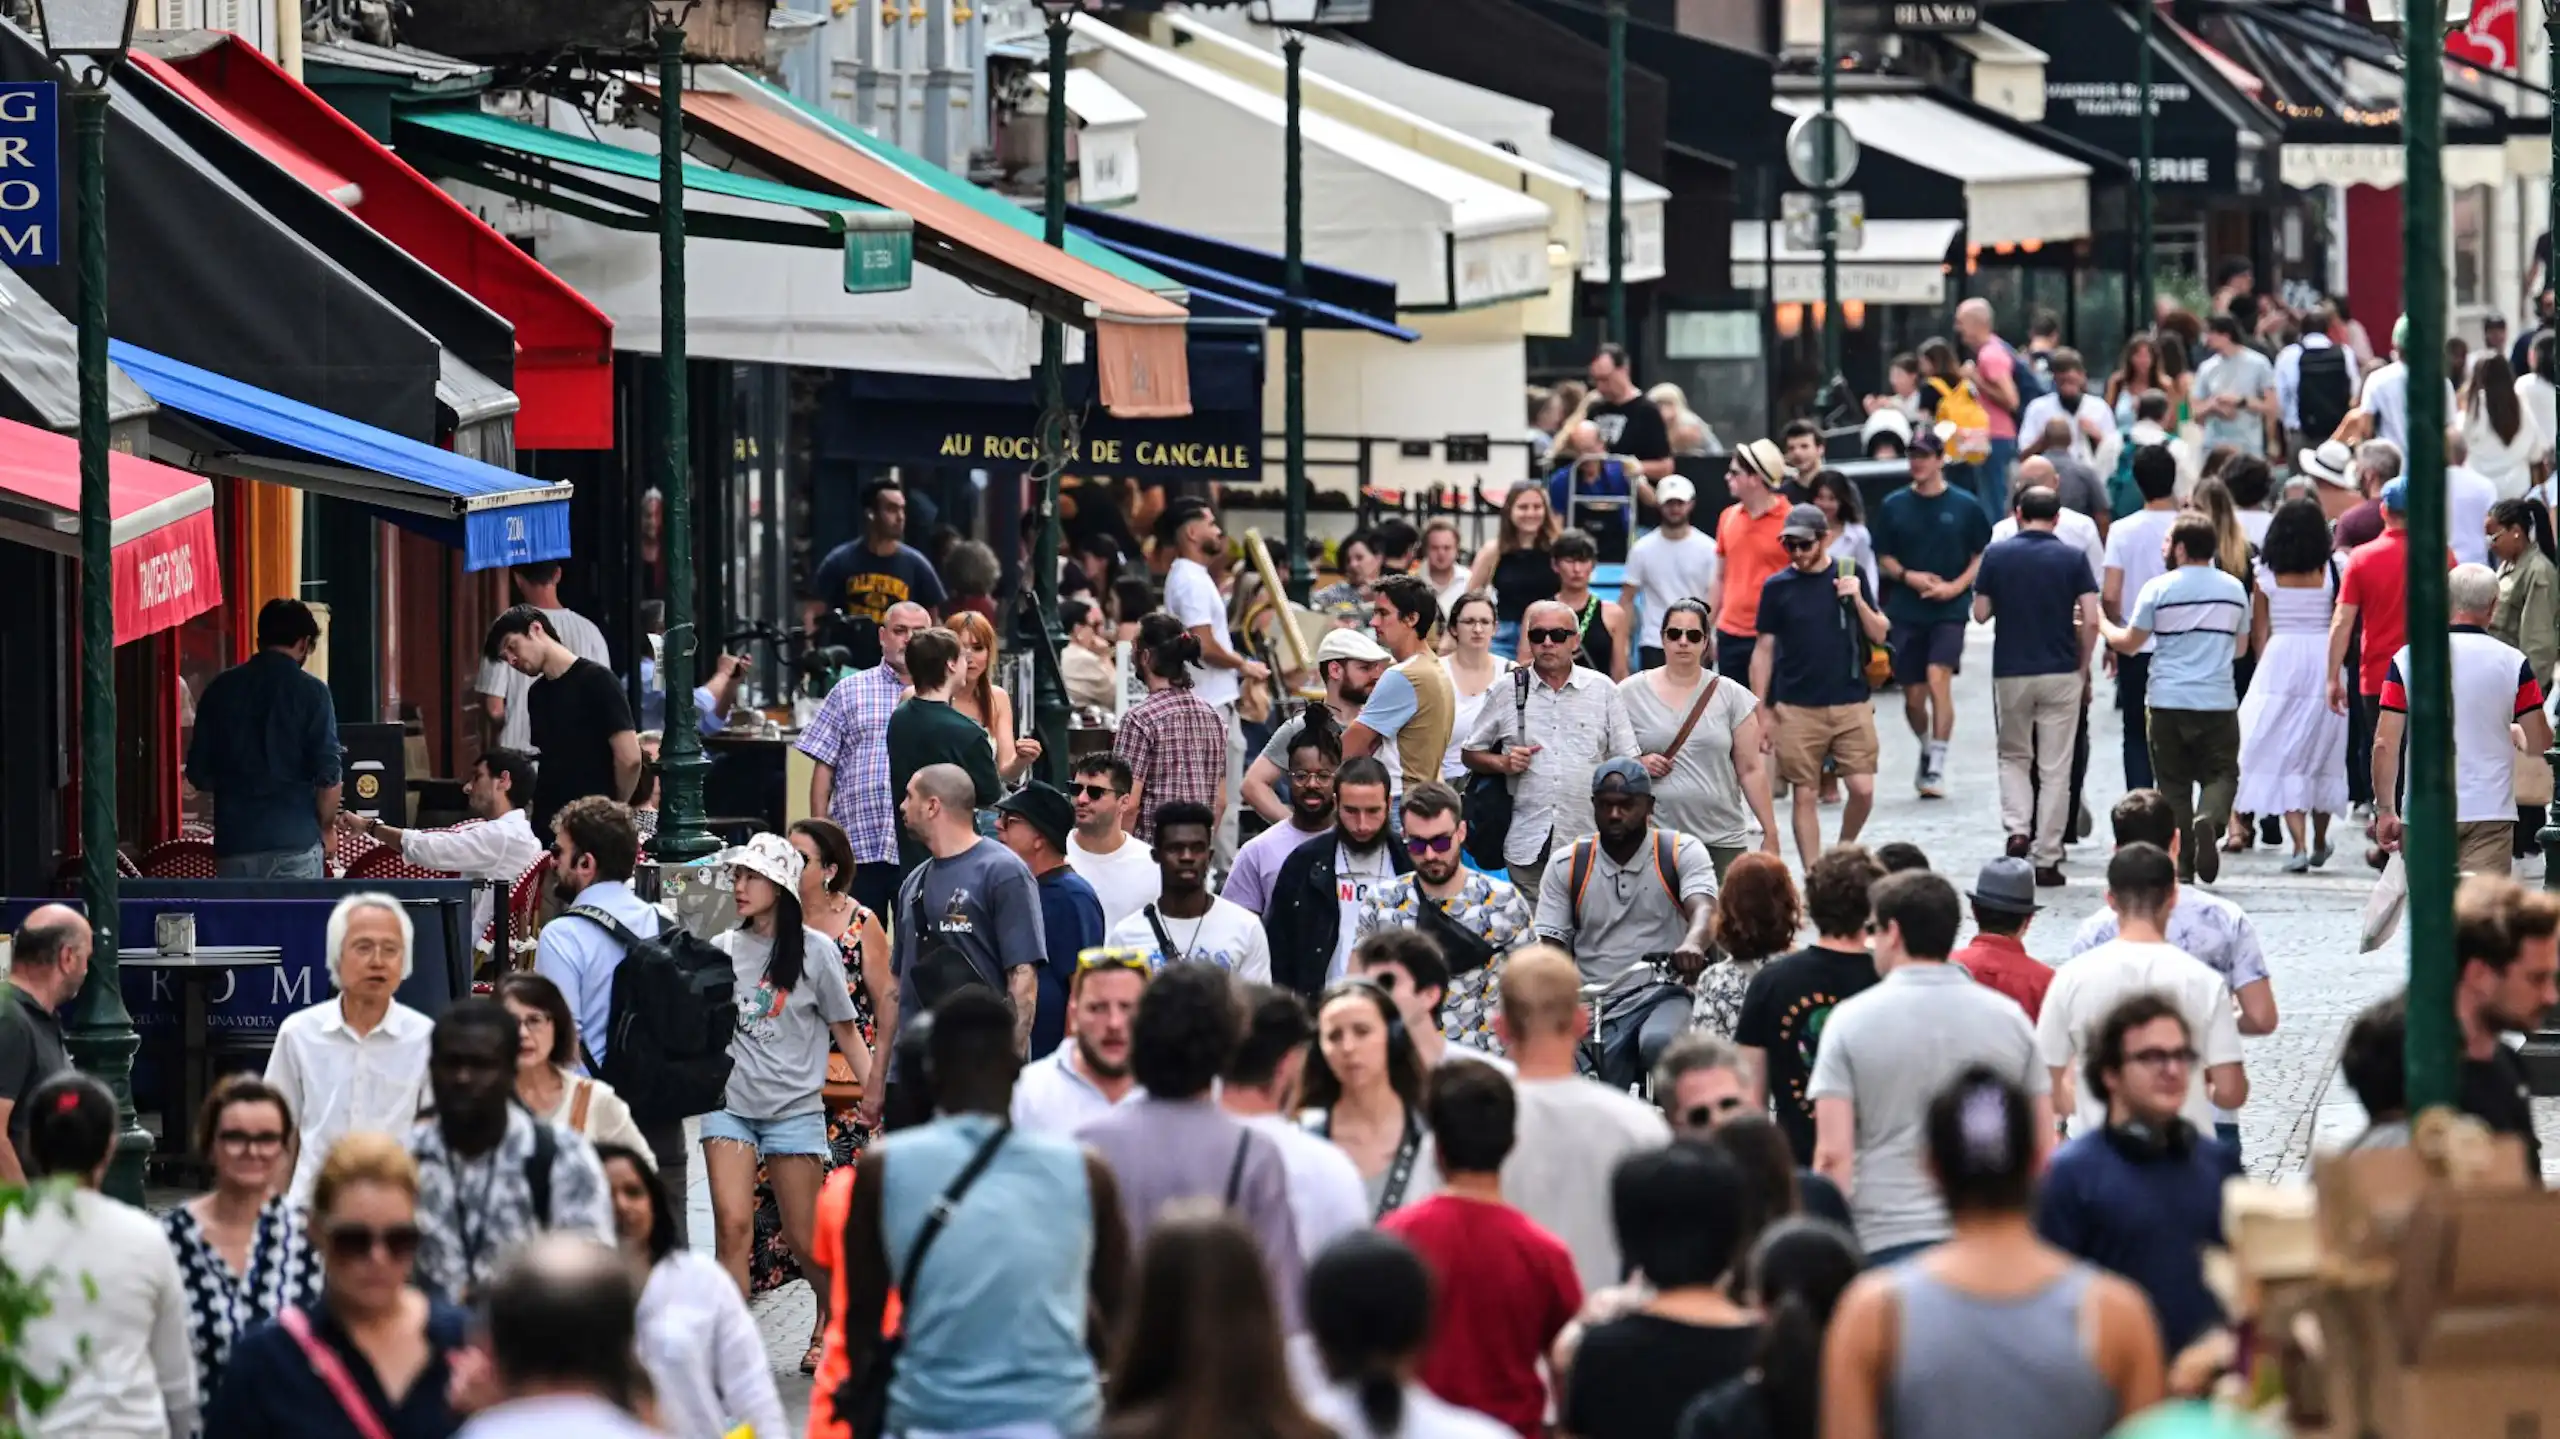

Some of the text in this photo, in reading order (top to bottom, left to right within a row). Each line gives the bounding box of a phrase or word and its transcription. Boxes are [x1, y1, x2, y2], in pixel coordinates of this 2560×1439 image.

[940, 433, 972, 457] AU
[1091, 439, 1123, 464] DE
[1135, 442, 1250, 470] CANCALE
[207, 1014, 235, 1027] UNA
[237, 1014, 276, 1028] VOLTA
